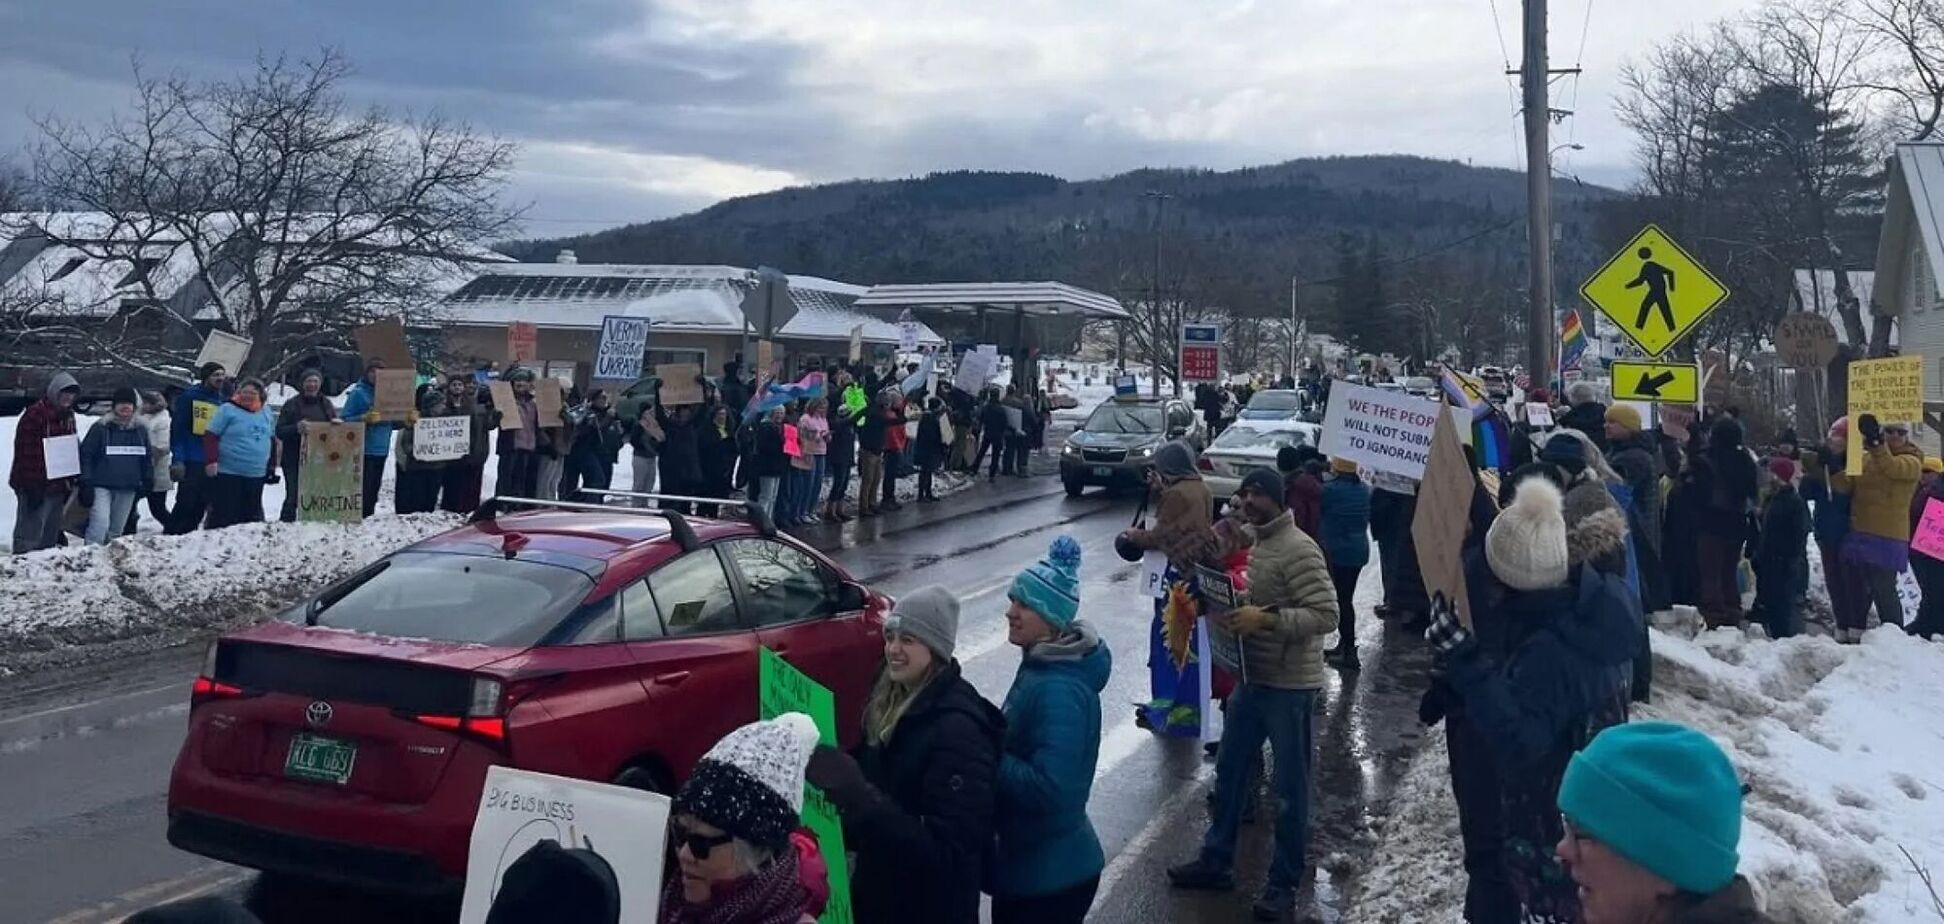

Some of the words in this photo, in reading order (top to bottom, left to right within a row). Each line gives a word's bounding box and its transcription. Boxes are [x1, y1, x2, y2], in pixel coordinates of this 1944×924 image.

[1852, 364, 1870, 376] THE
[1348, 399, 1369, 414] WE
[1372, 403, 1398, 420] THE
[1399, 410, 1435, 428] PEOP
[1344, 417, 1371, 433] WILL
[1373, 424, 1399, 438] NOT
[1400, 430, 1433, 447] SUBM
[1350, 437, 1365, 449] TO
[1367, 441, 1428, 465] IGNORANC
[301, 493, 362, 512] UKRAINE
[486, 787, 510, 808] BIG
[510, 794, 575, 821] BUSINESS
